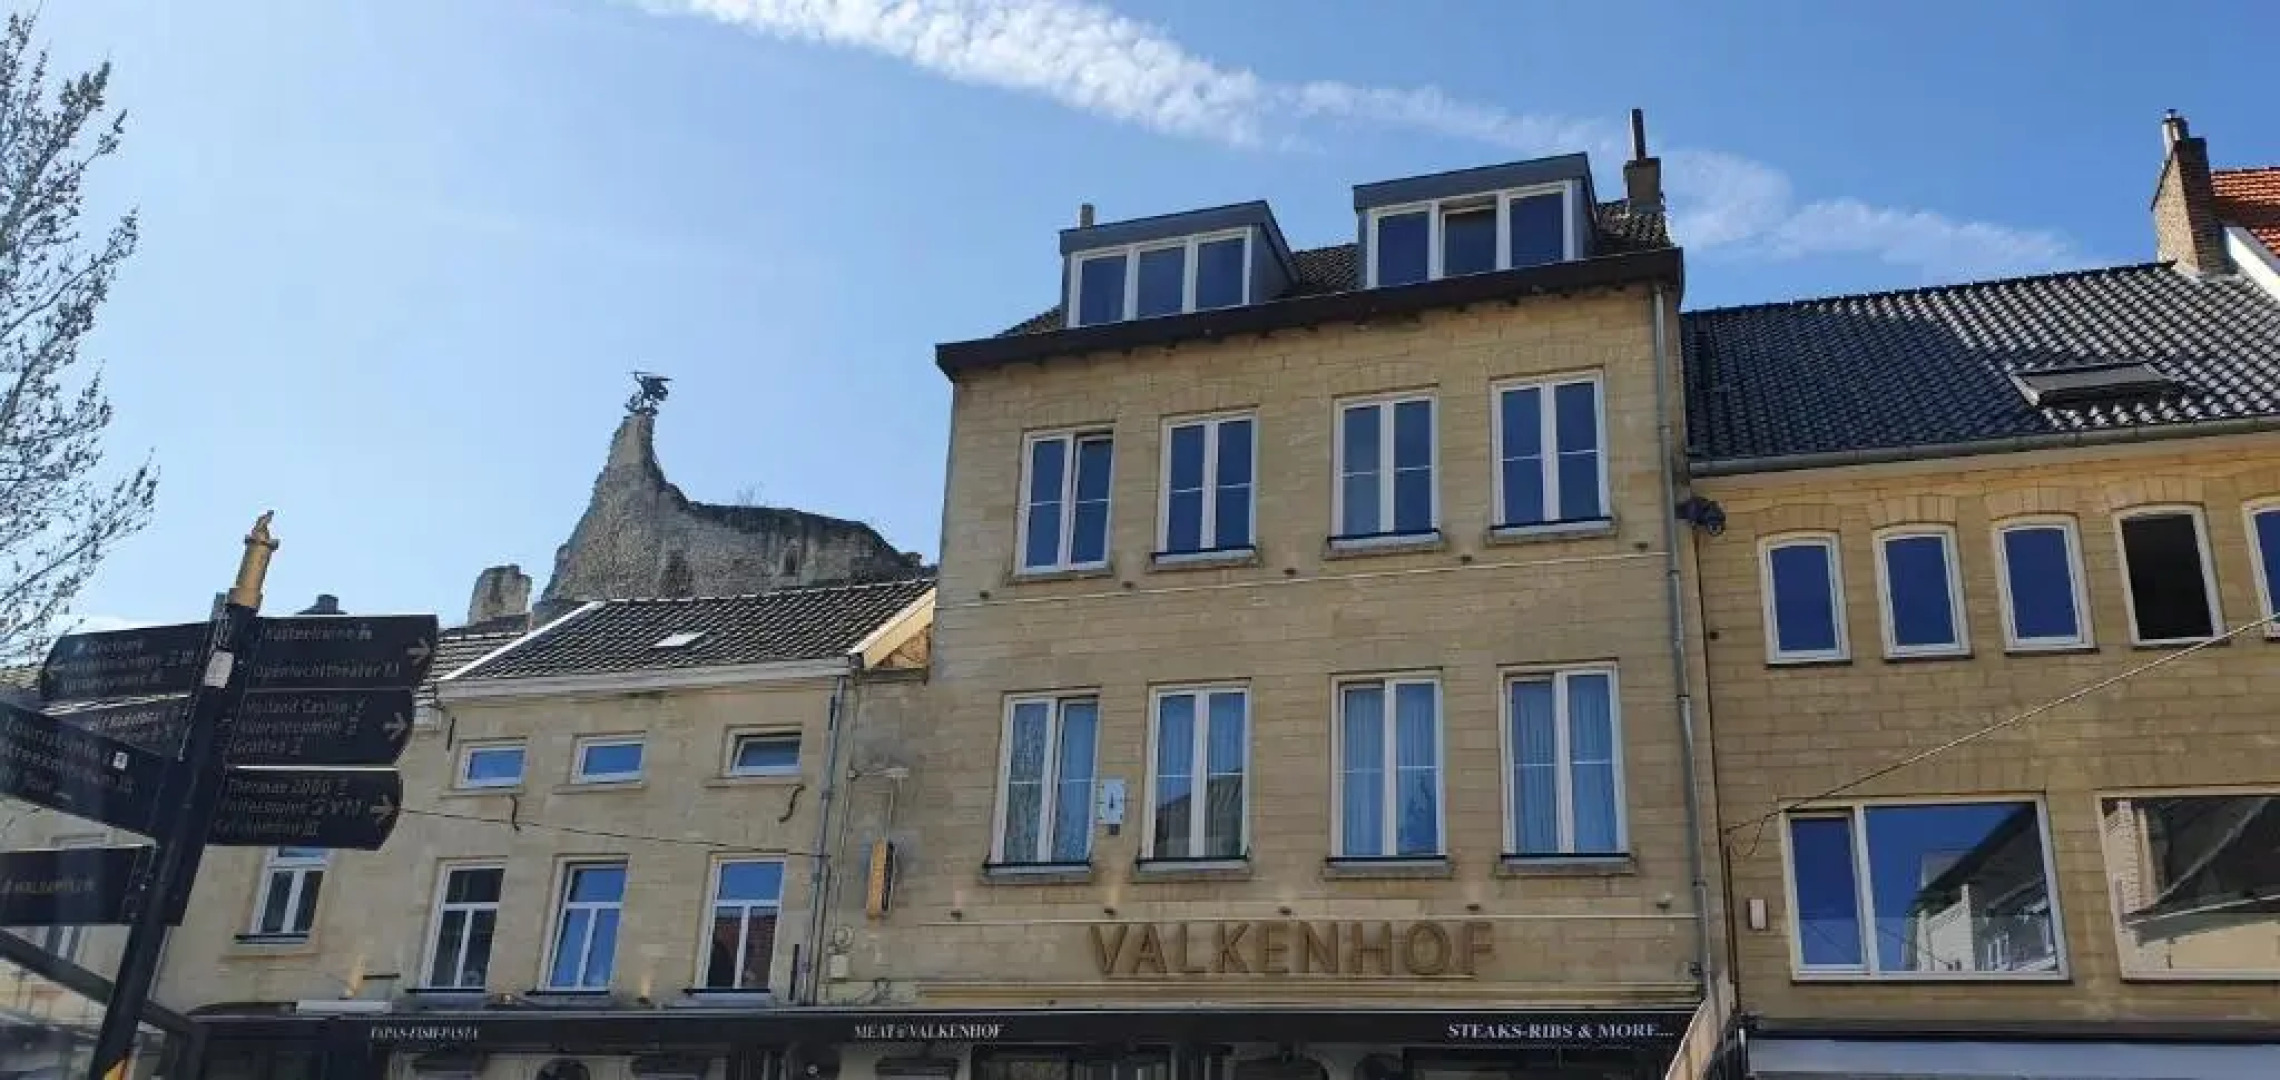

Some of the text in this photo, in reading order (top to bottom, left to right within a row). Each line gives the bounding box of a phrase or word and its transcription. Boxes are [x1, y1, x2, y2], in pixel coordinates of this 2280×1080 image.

[1087, 920, 1496, 977] VALKENHOF
[1448, 1022, 1573, 1039] STEAKS-RIBS
[1577, 1023, 1594, 1039] &
